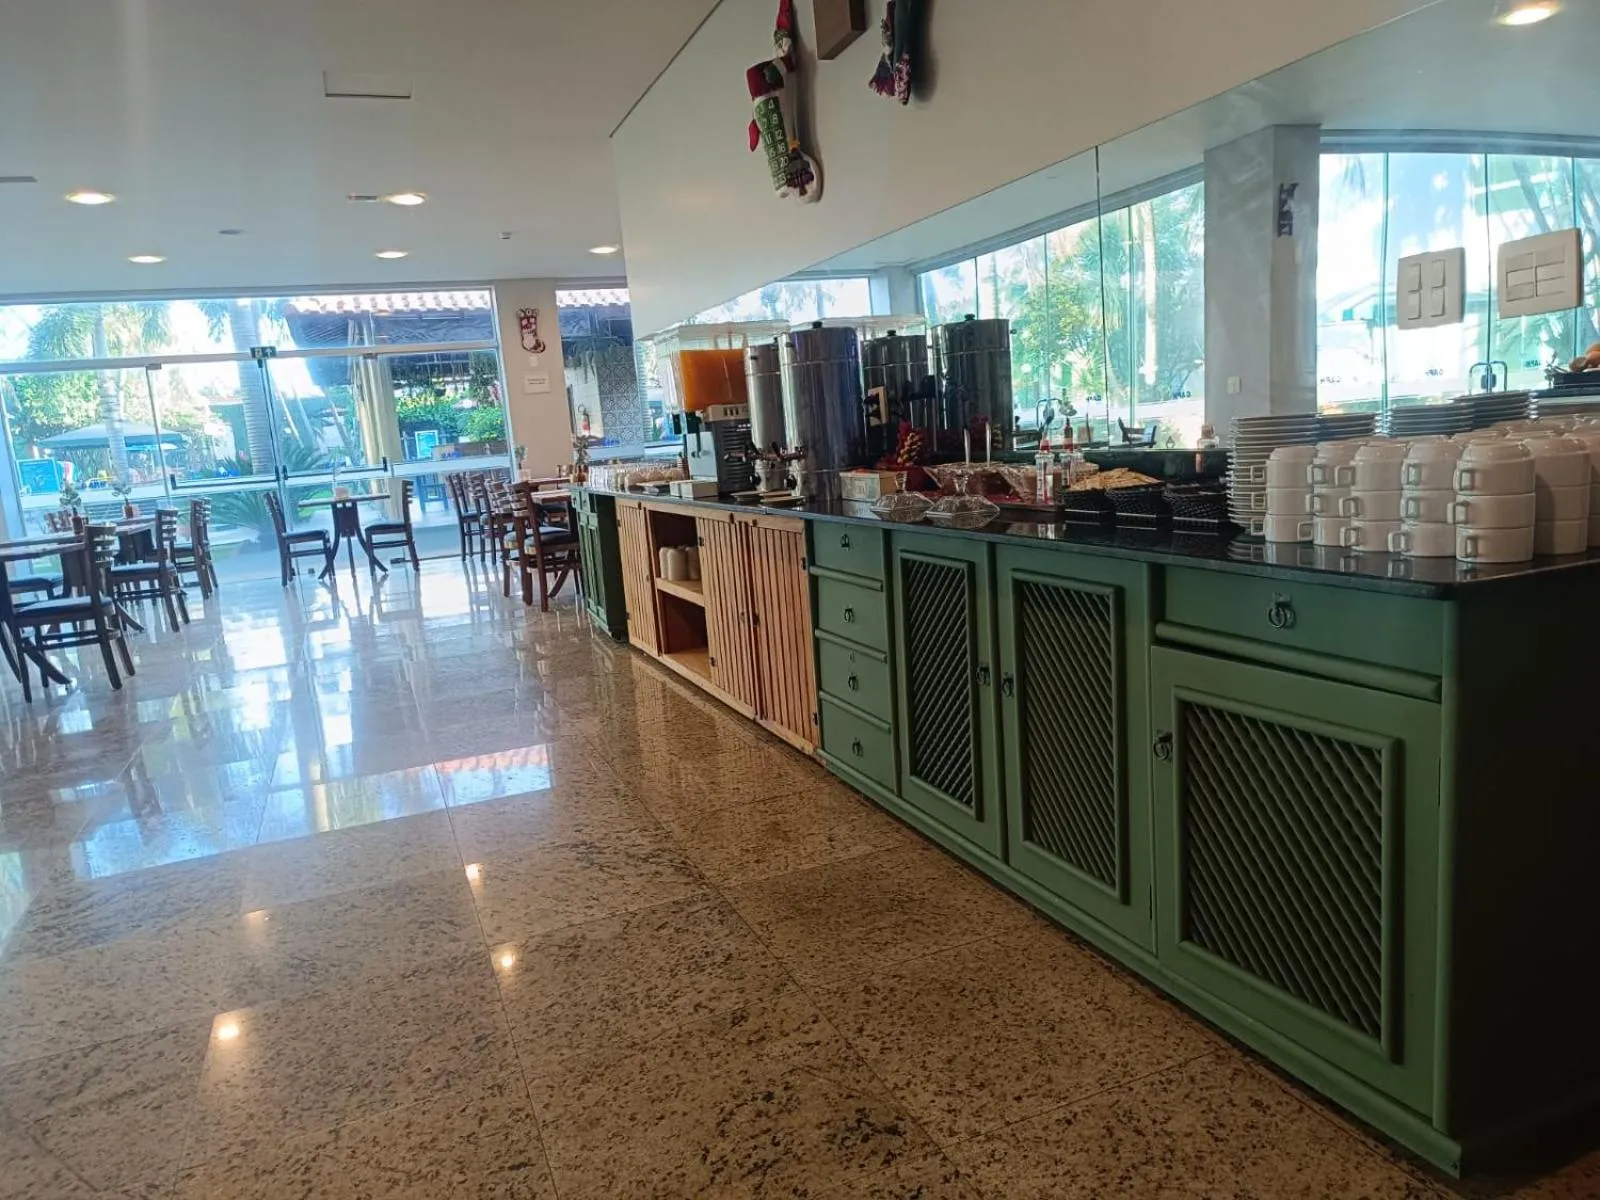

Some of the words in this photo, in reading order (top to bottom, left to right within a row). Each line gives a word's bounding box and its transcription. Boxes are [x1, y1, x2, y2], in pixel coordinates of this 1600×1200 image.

[768, 99, 775, 109] 4
[772, 113, 779, 124] 8
[775, 129, 784, 140] 12
[780, 156, 789, 168] 20
